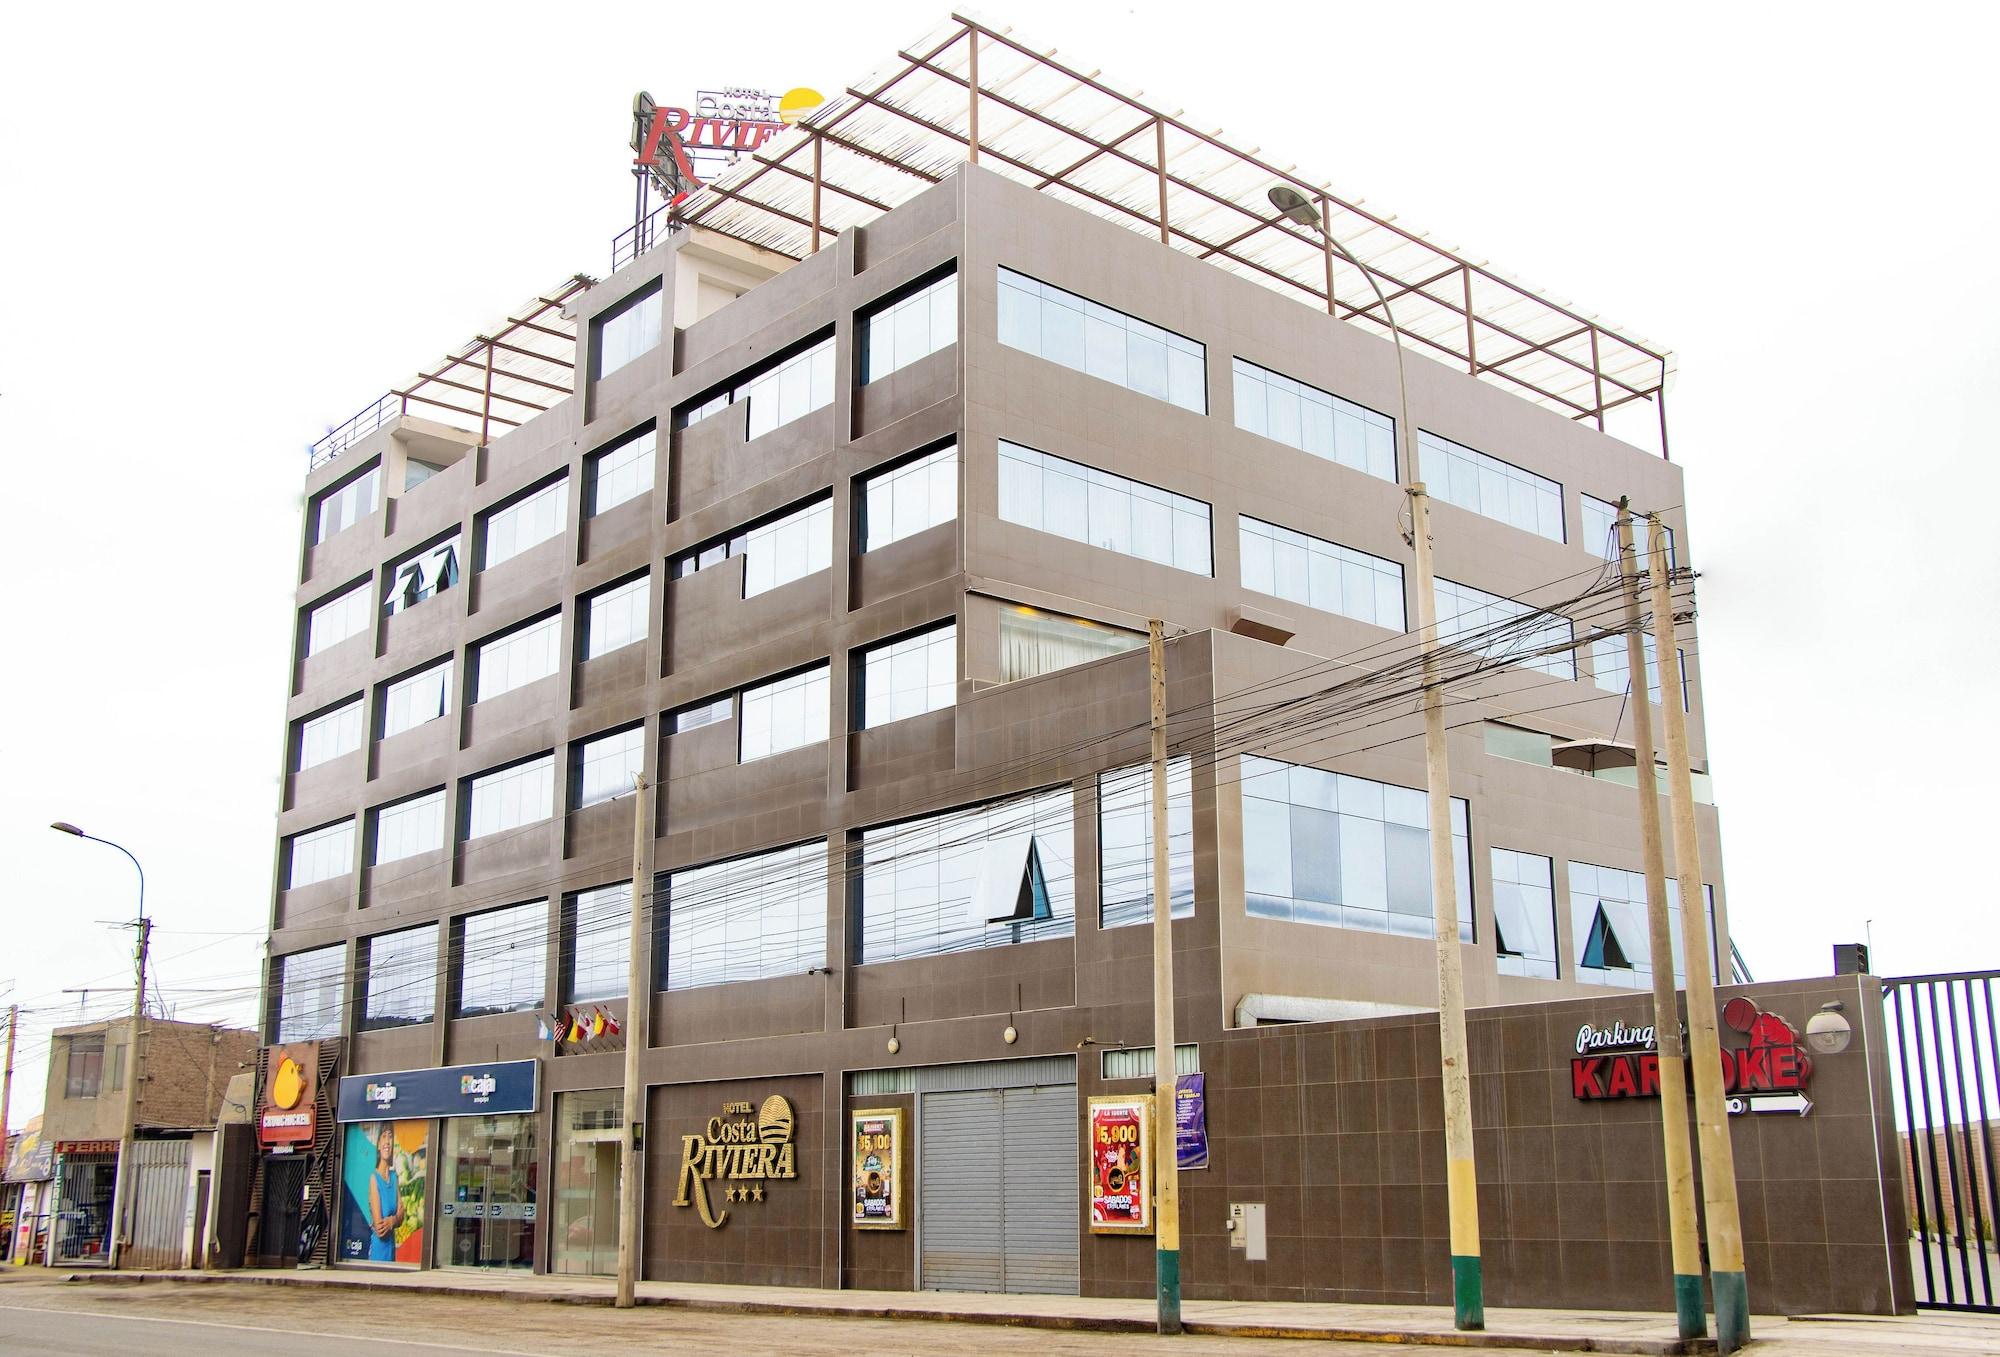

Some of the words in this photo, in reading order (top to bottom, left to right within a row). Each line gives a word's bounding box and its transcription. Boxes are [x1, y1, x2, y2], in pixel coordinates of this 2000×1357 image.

[723, 86, 770, 100] HOTEL
[696, 96, 775, 122] Costa
[634, 107, 791, 185] RIVIE
[1576, 1021, 1655, 1054] Parking
[375, 1081, 397, 1103] caja
[471, 1073, 496, 1096] caja
[723, 1101, 753, 1115] HOTEL
[707, 1116, 757, 1144] Costa
[672, 1134, 797, 1229] RIVIERA
